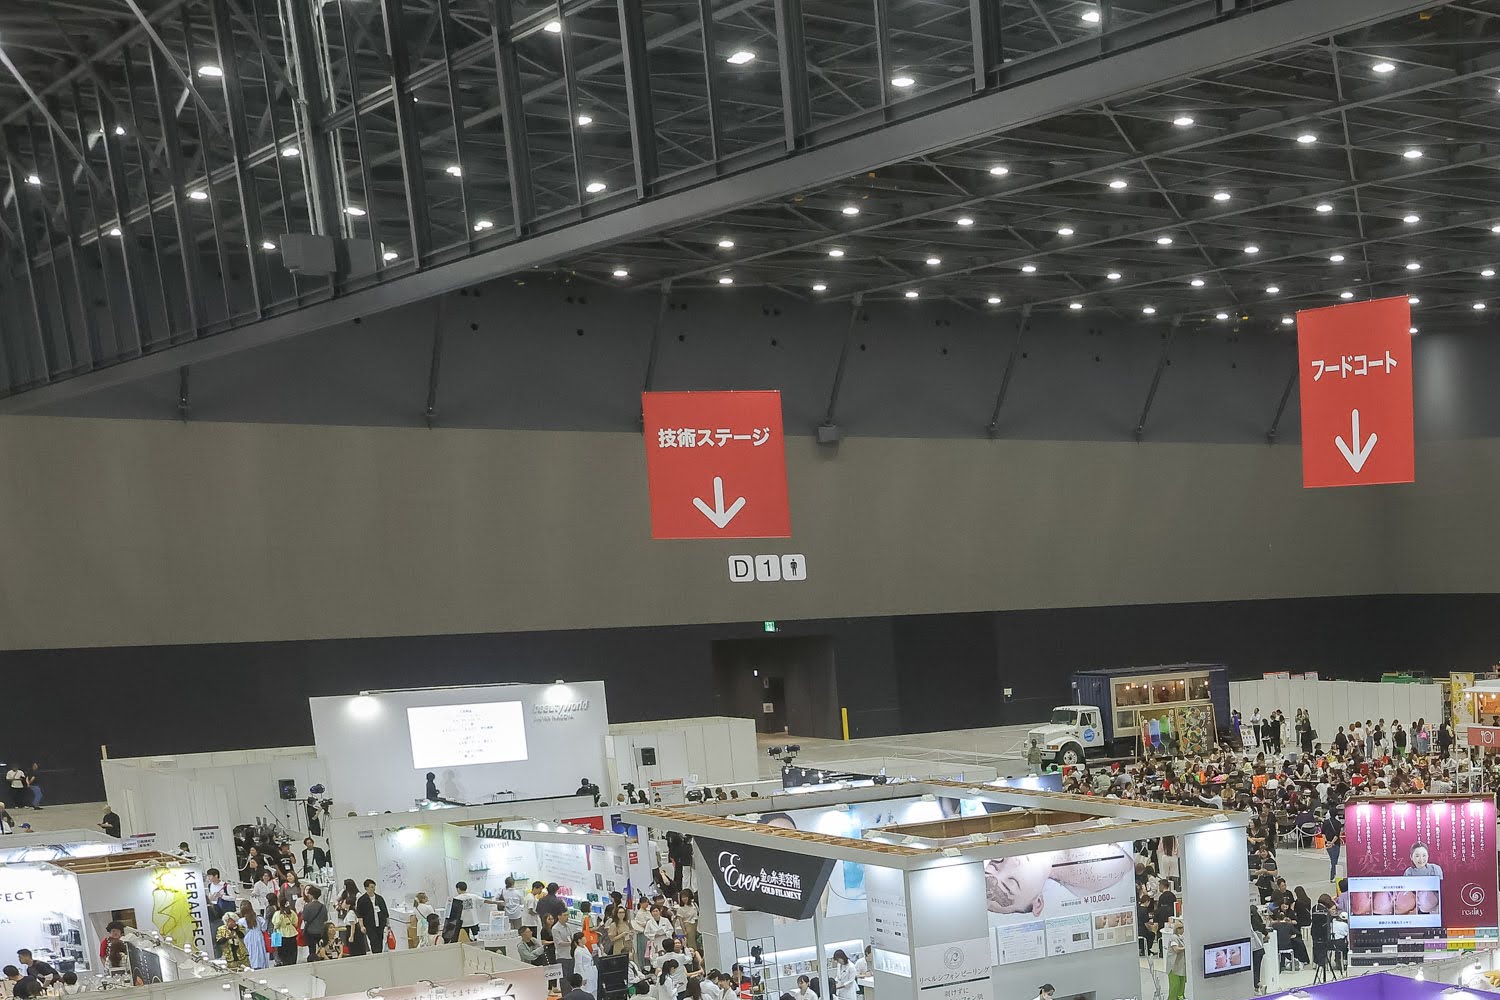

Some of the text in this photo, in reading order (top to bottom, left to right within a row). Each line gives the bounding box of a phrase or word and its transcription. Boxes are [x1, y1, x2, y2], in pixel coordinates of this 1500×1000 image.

[1311, 350, 1398, 381] フードコート
[658, 427, 770, 449] 技術ステージ
